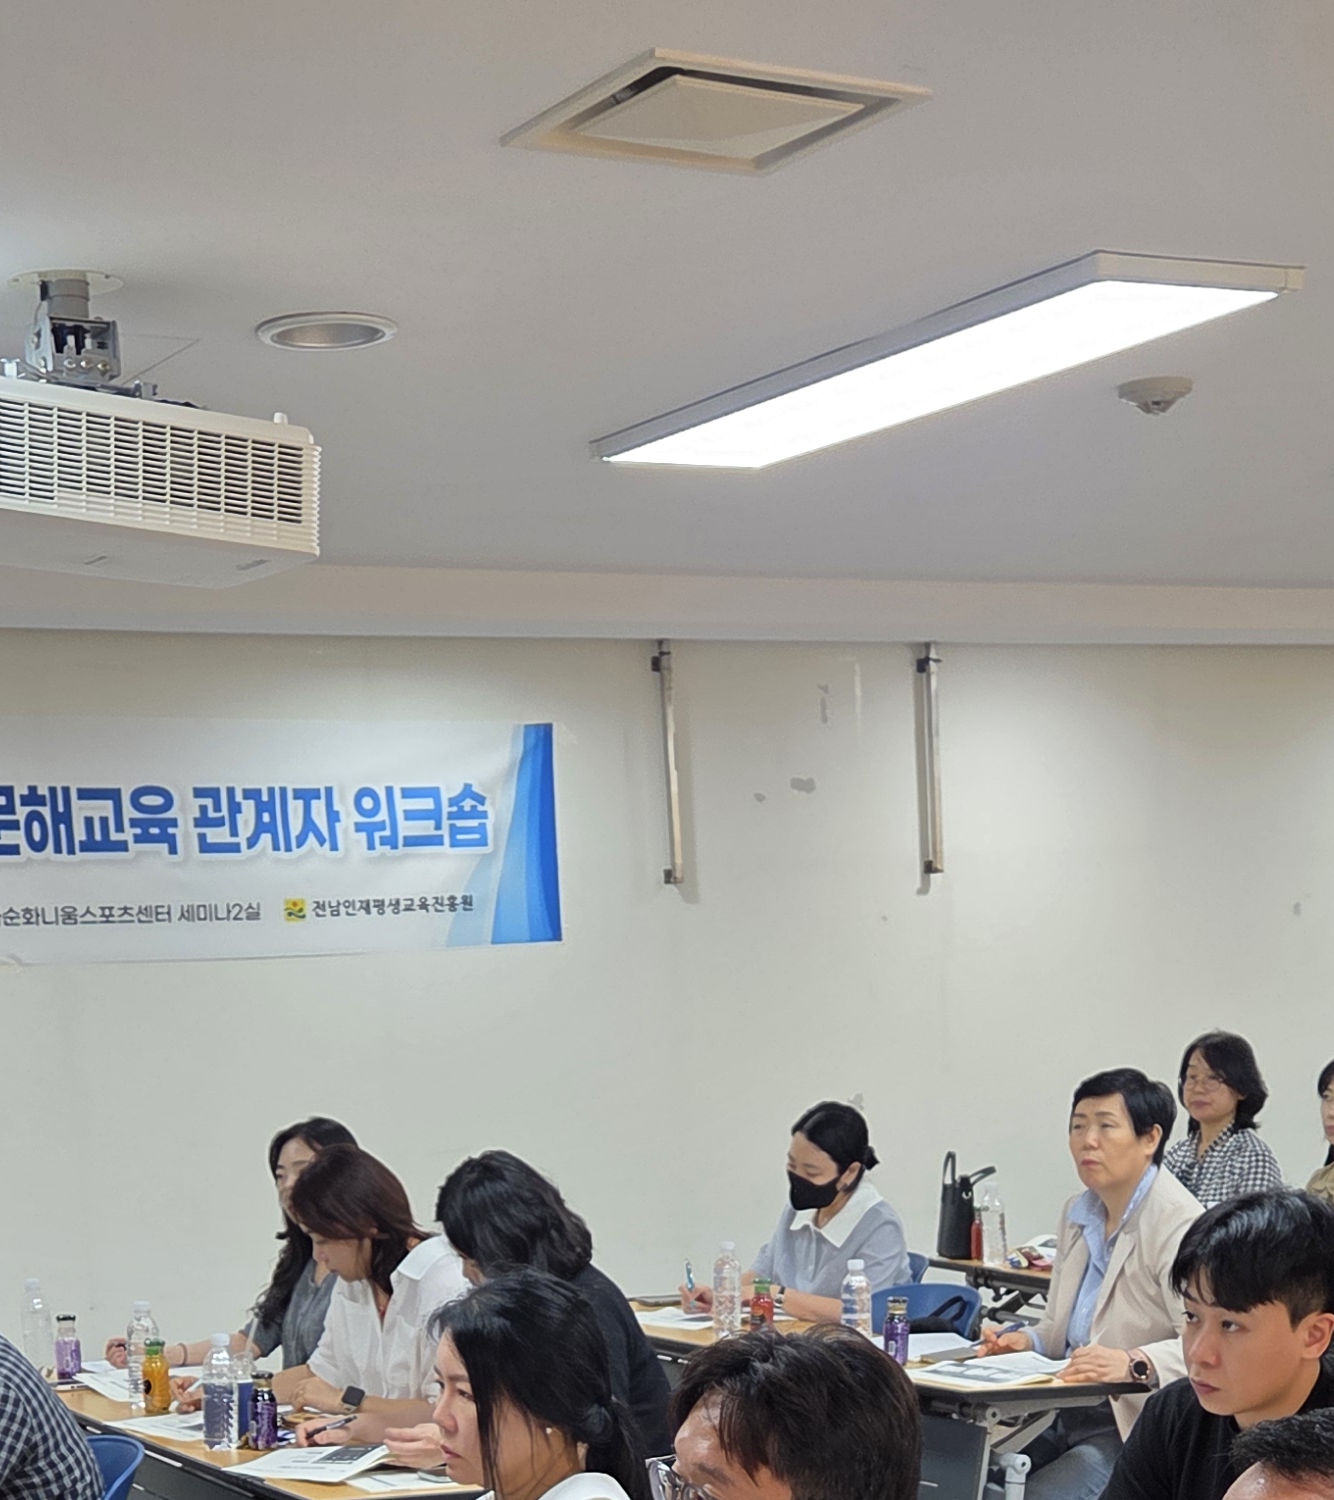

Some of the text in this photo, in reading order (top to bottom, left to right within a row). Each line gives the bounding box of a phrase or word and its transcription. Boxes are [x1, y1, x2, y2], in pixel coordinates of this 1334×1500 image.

[192, 785, 340, 854] 관계자
[354, 783, 488, 850] 워크숍
[177, 902, 261, 924] 세미나2실
[311, 893, 474, 918] 전남인재평생교육진흥원
